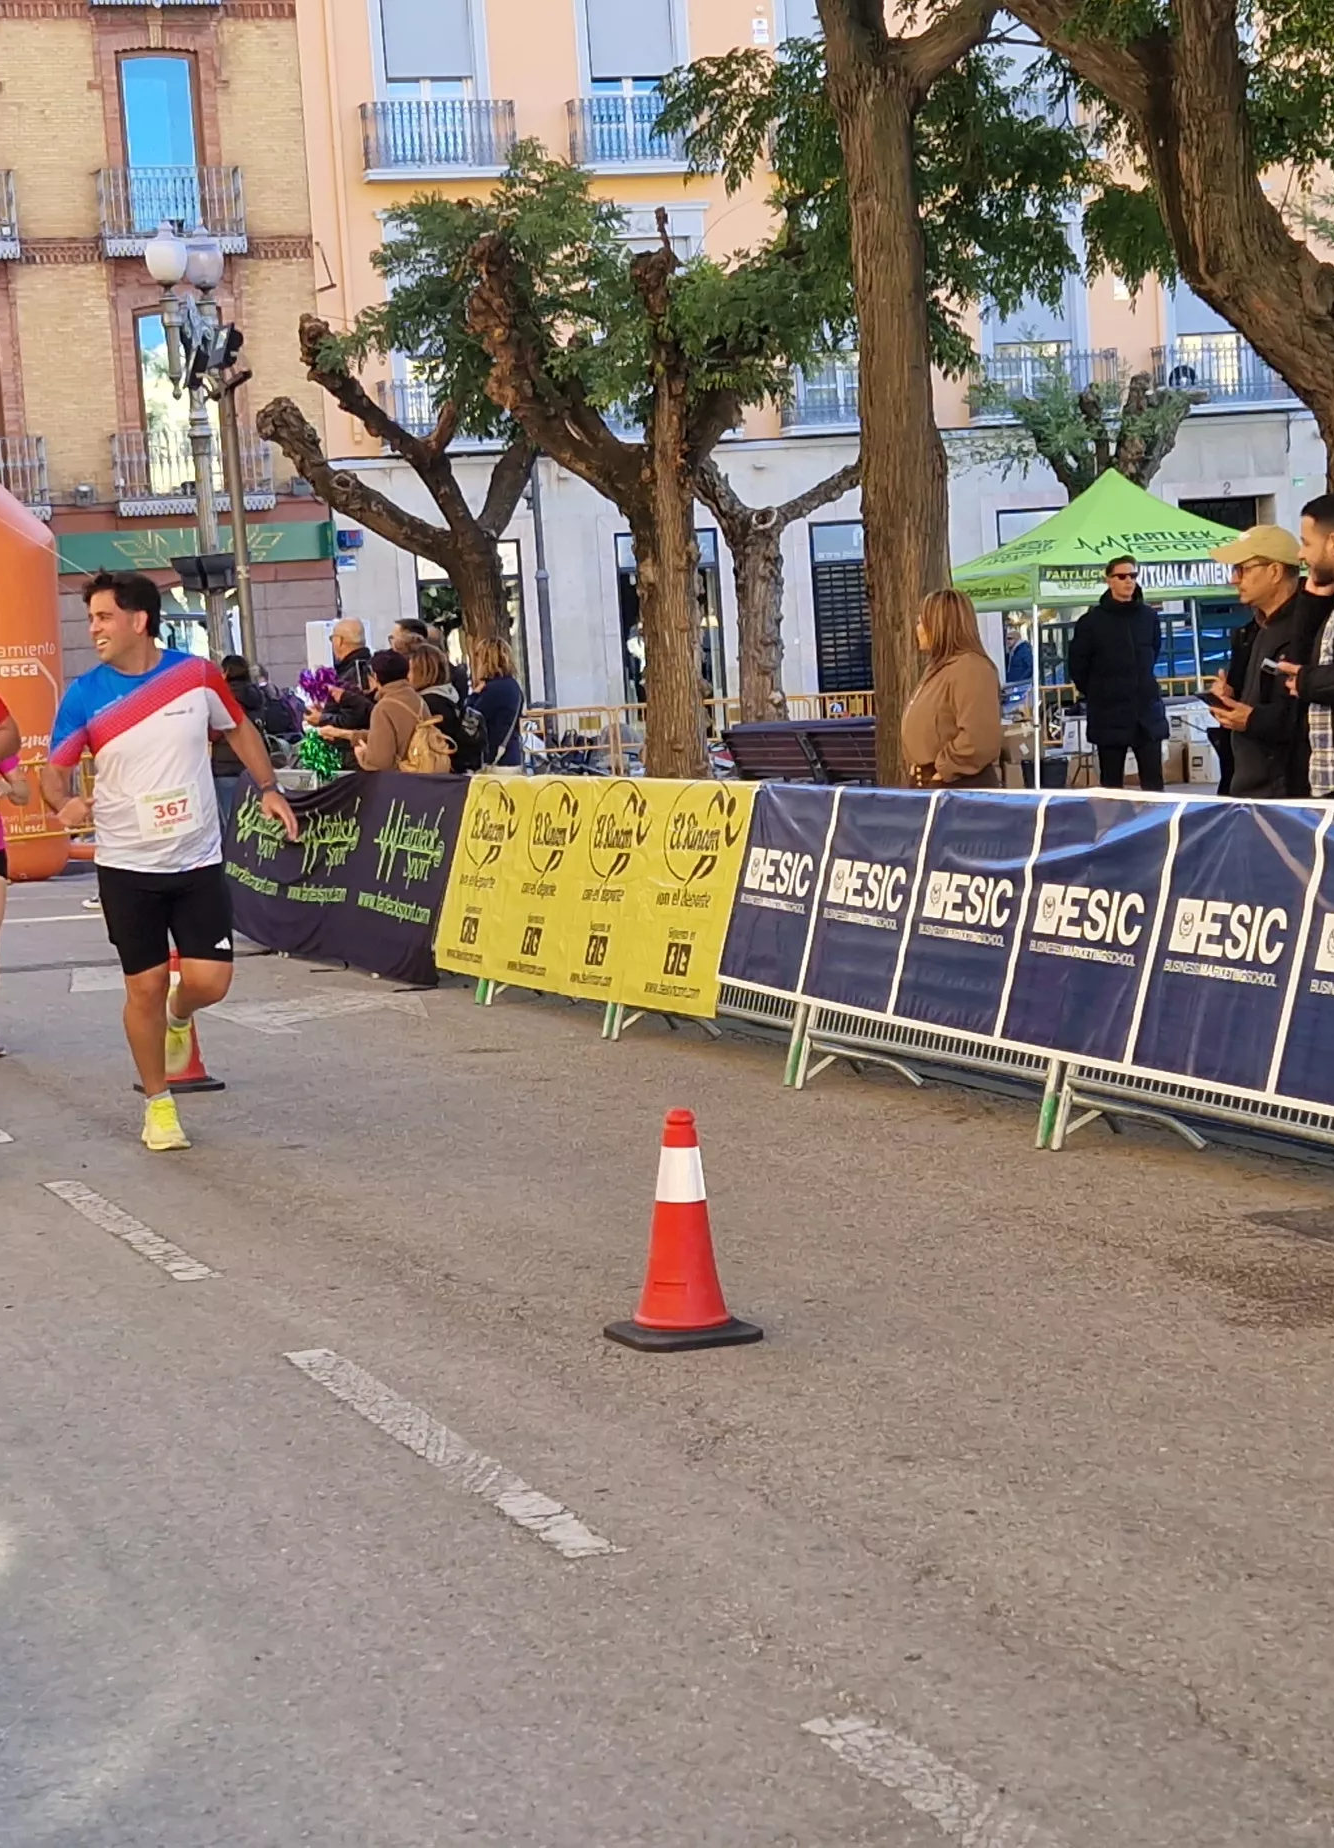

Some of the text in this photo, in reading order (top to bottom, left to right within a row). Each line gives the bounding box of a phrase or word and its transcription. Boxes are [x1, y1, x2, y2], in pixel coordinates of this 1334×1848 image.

[1223, 482, 1231, 495] 2
[1121, 530, 1216, 542] FARTLECK
[1046, 569, 1106, 580] FARTLECK
[153, 798, 188, 819] 367
[761, 848, 813, 898] ESIC
[845, 861, 907, 912] ESIC
[943, 873, 1013, 928] ESIC
[1058, 886, 1145, 946] ESIC
[1197, 900, 1287, 965] ESIC
